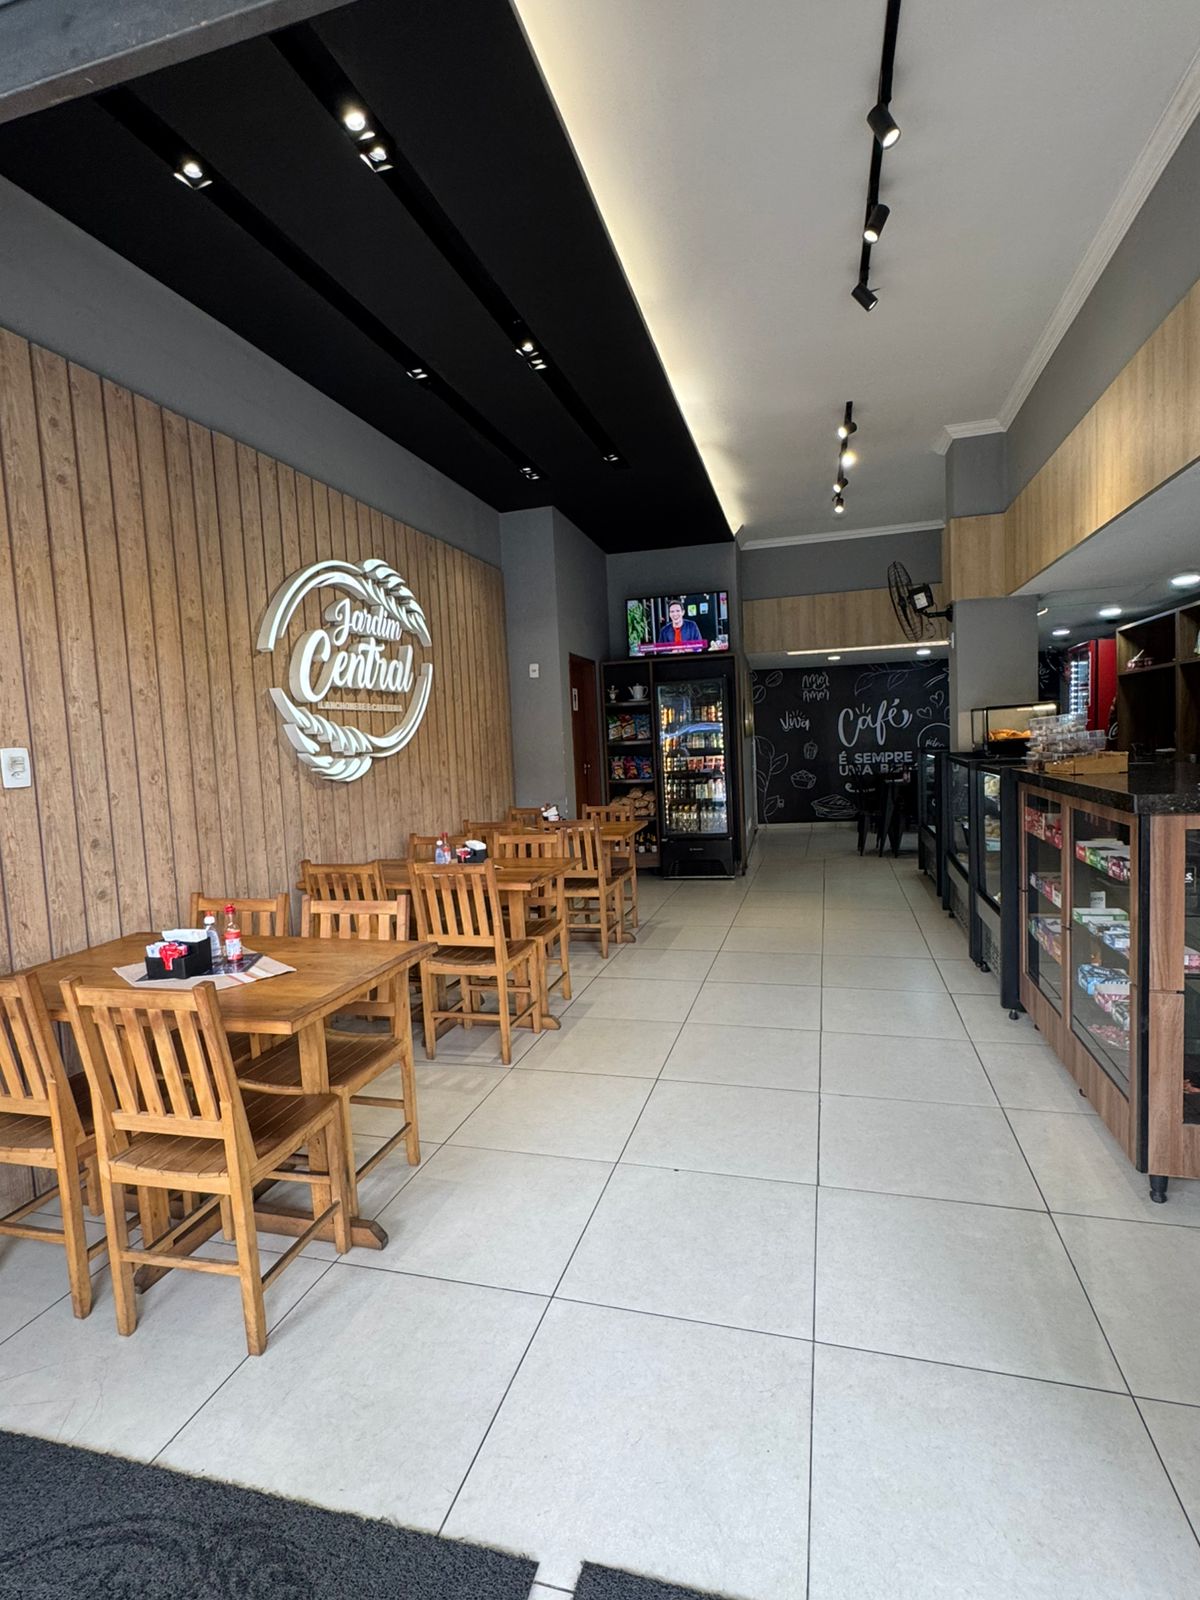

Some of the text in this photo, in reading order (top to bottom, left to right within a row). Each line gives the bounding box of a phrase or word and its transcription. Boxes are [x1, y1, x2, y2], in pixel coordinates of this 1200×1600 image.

[333, 598, 403, 646] Jardim
[298, 628, 414, 703] Central
[838, 699, 912, 747] Café
[838, 750, 913, 765] É SEMPRE
